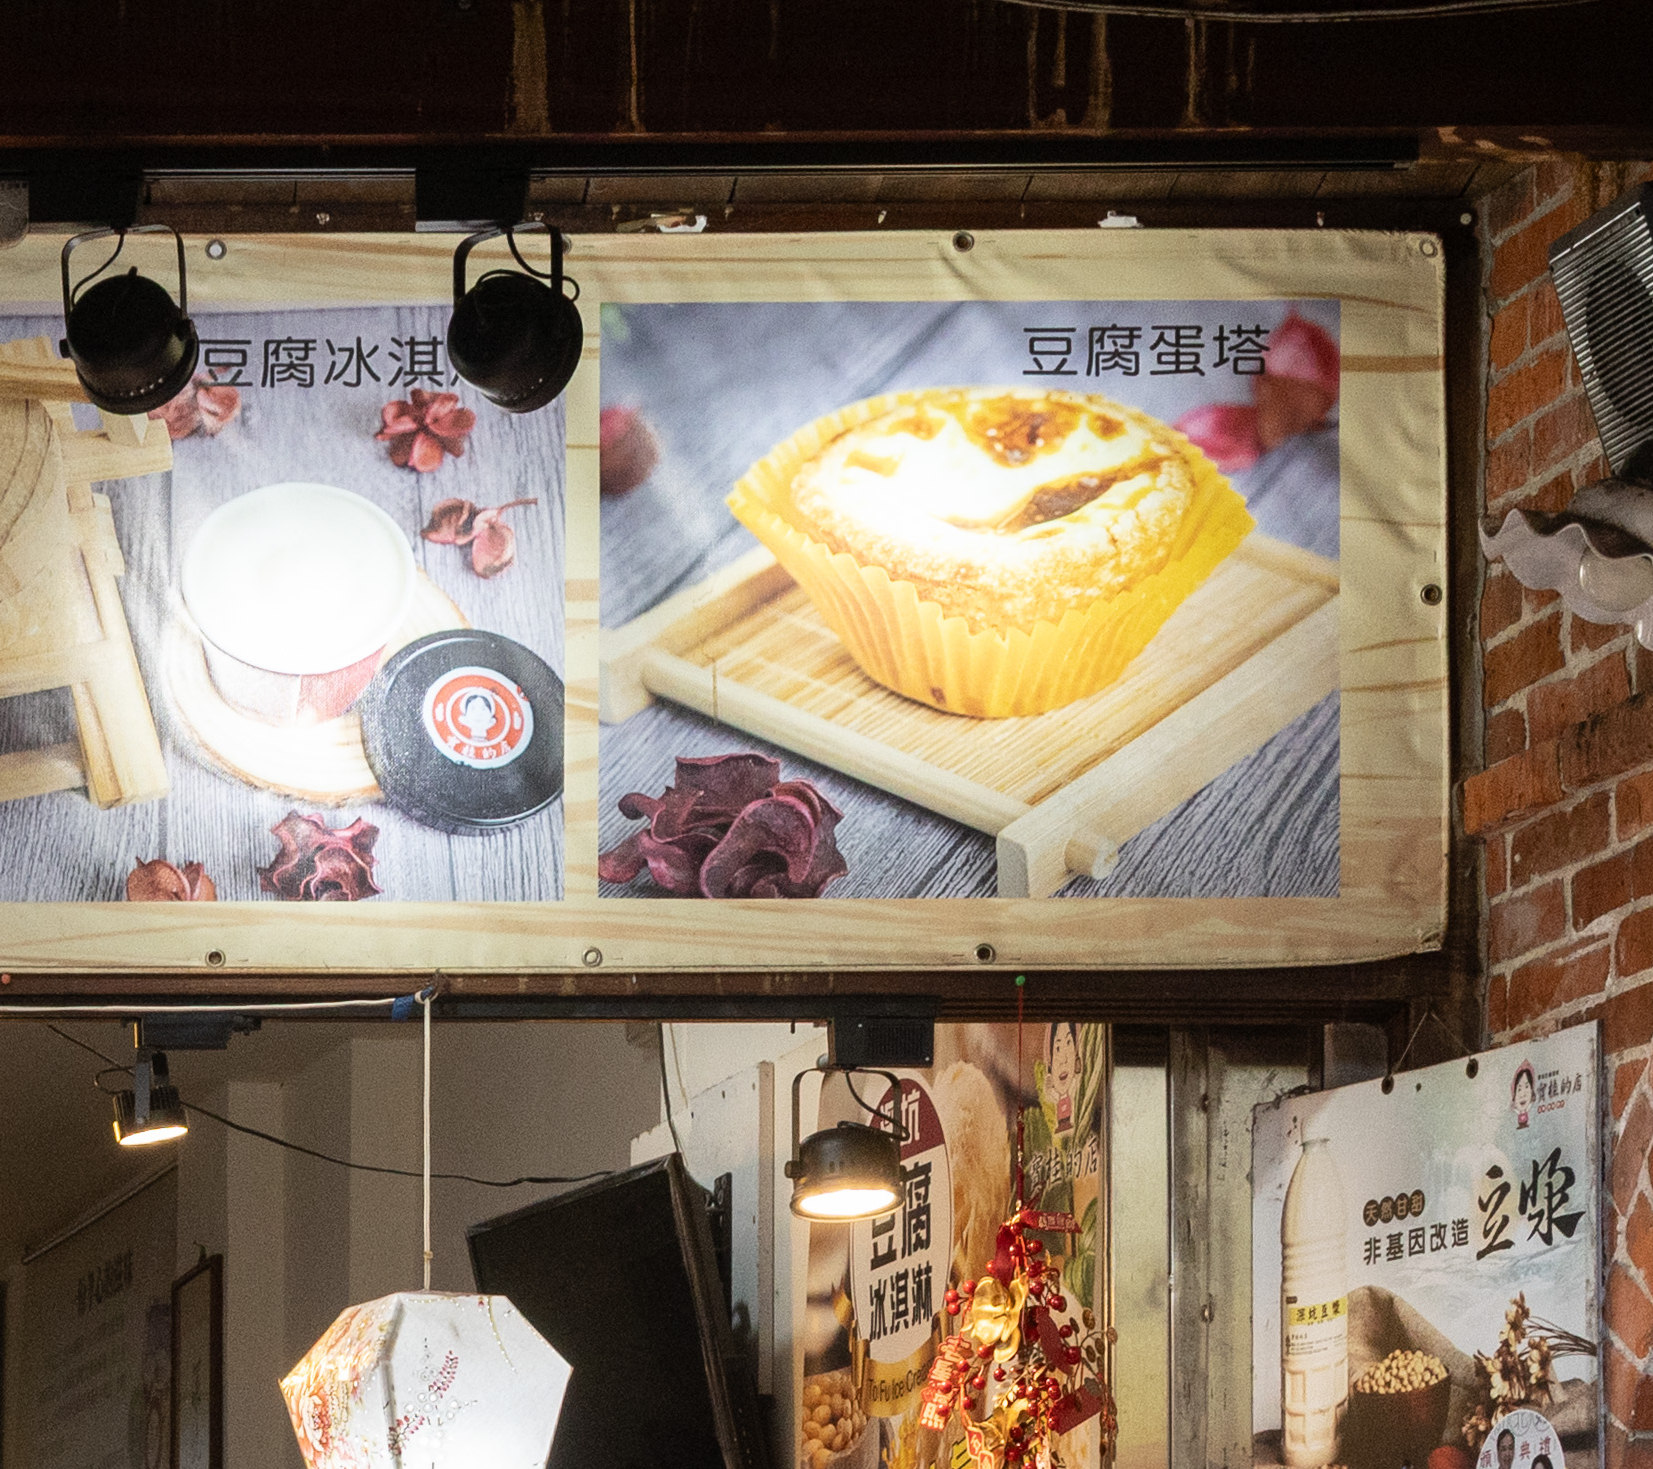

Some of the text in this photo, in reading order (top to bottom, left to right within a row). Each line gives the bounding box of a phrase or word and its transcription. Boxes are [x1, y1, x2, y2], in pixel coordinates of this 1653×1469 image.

[1022, 323, 1272, 379] 豆腐蛋塔
[1365, 1192, 1424, 1225] 天然甘甜
[1476, 1147, 1586, 1262] 豆漿
[1364, 1218, 1470, 1266] 非基因改造
[869, 1262, 933, 1342] 冰淇淋
